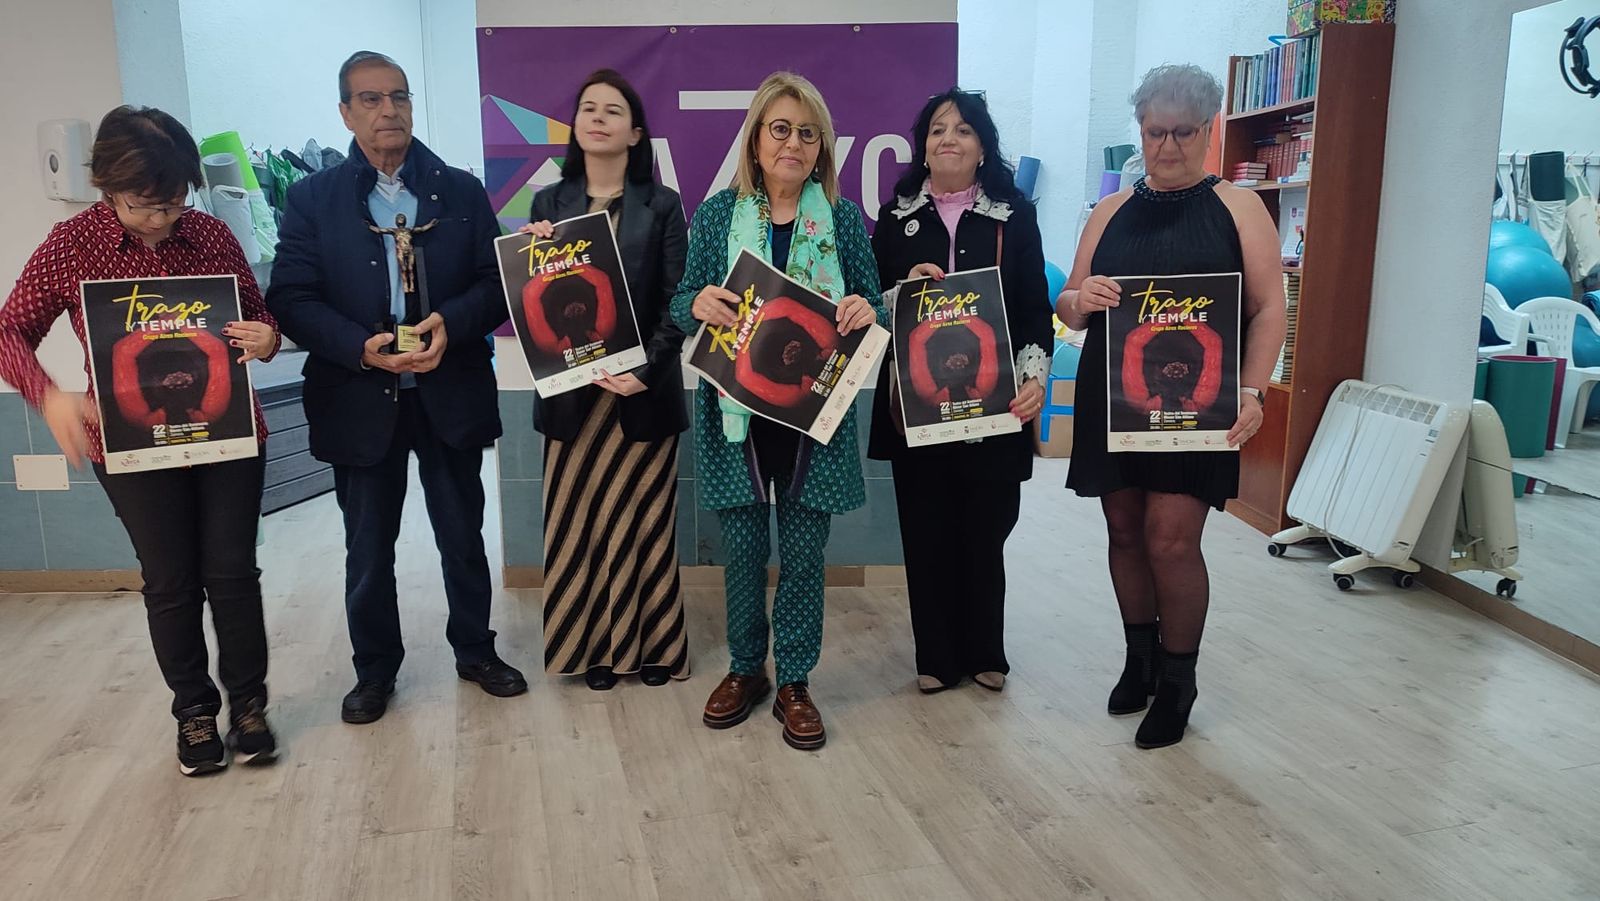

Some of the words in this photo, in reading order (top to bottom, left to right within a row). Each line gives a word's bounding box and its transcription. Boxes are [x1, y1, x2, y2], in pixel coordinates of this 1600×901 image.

[537, 254, 592, 275] TEMPLE
[926, 306, 979, 322] TEMPLE
[1148, 311, 1208, 324] TEMPLE
[137, 317, 208, 332] TEMPLE
[732, 295, 765, 350] TEMPLE
[563, 348, 574, 358] 22
[811, 381, 822, 394] 22
[940, 401, 950, 411] 22
[1150, 410, 1161, 420] 22
[152, 424, 166, 434] 22
